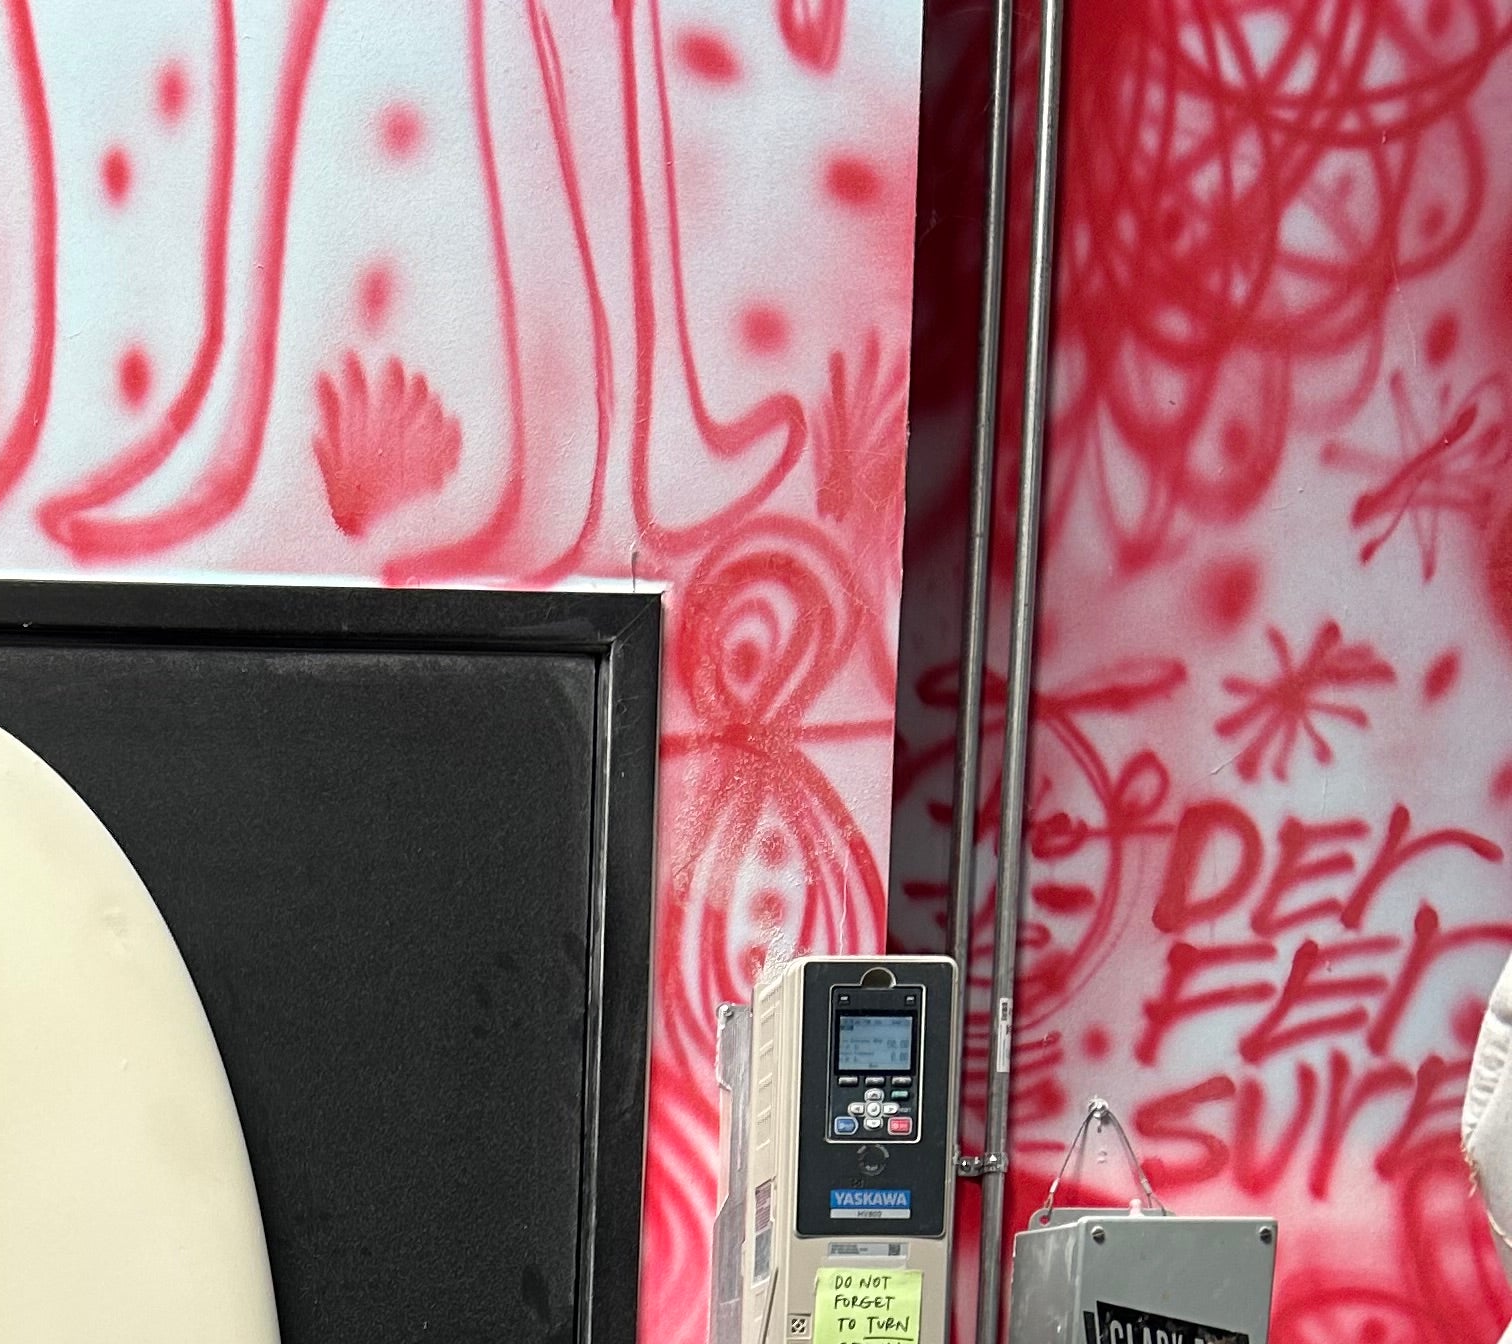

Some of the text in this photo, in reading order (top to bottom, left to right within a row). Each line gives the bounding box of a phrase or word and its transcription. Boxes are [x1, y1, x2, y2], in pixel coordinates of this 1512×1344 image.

[835, 1191, 907, 1206] YASKAWA
[835, 1275, 892, 1290] DO NOT
[834, 1294, 895, 1310] FORGET
[838, 1316, 909, 1334] TO TURN
